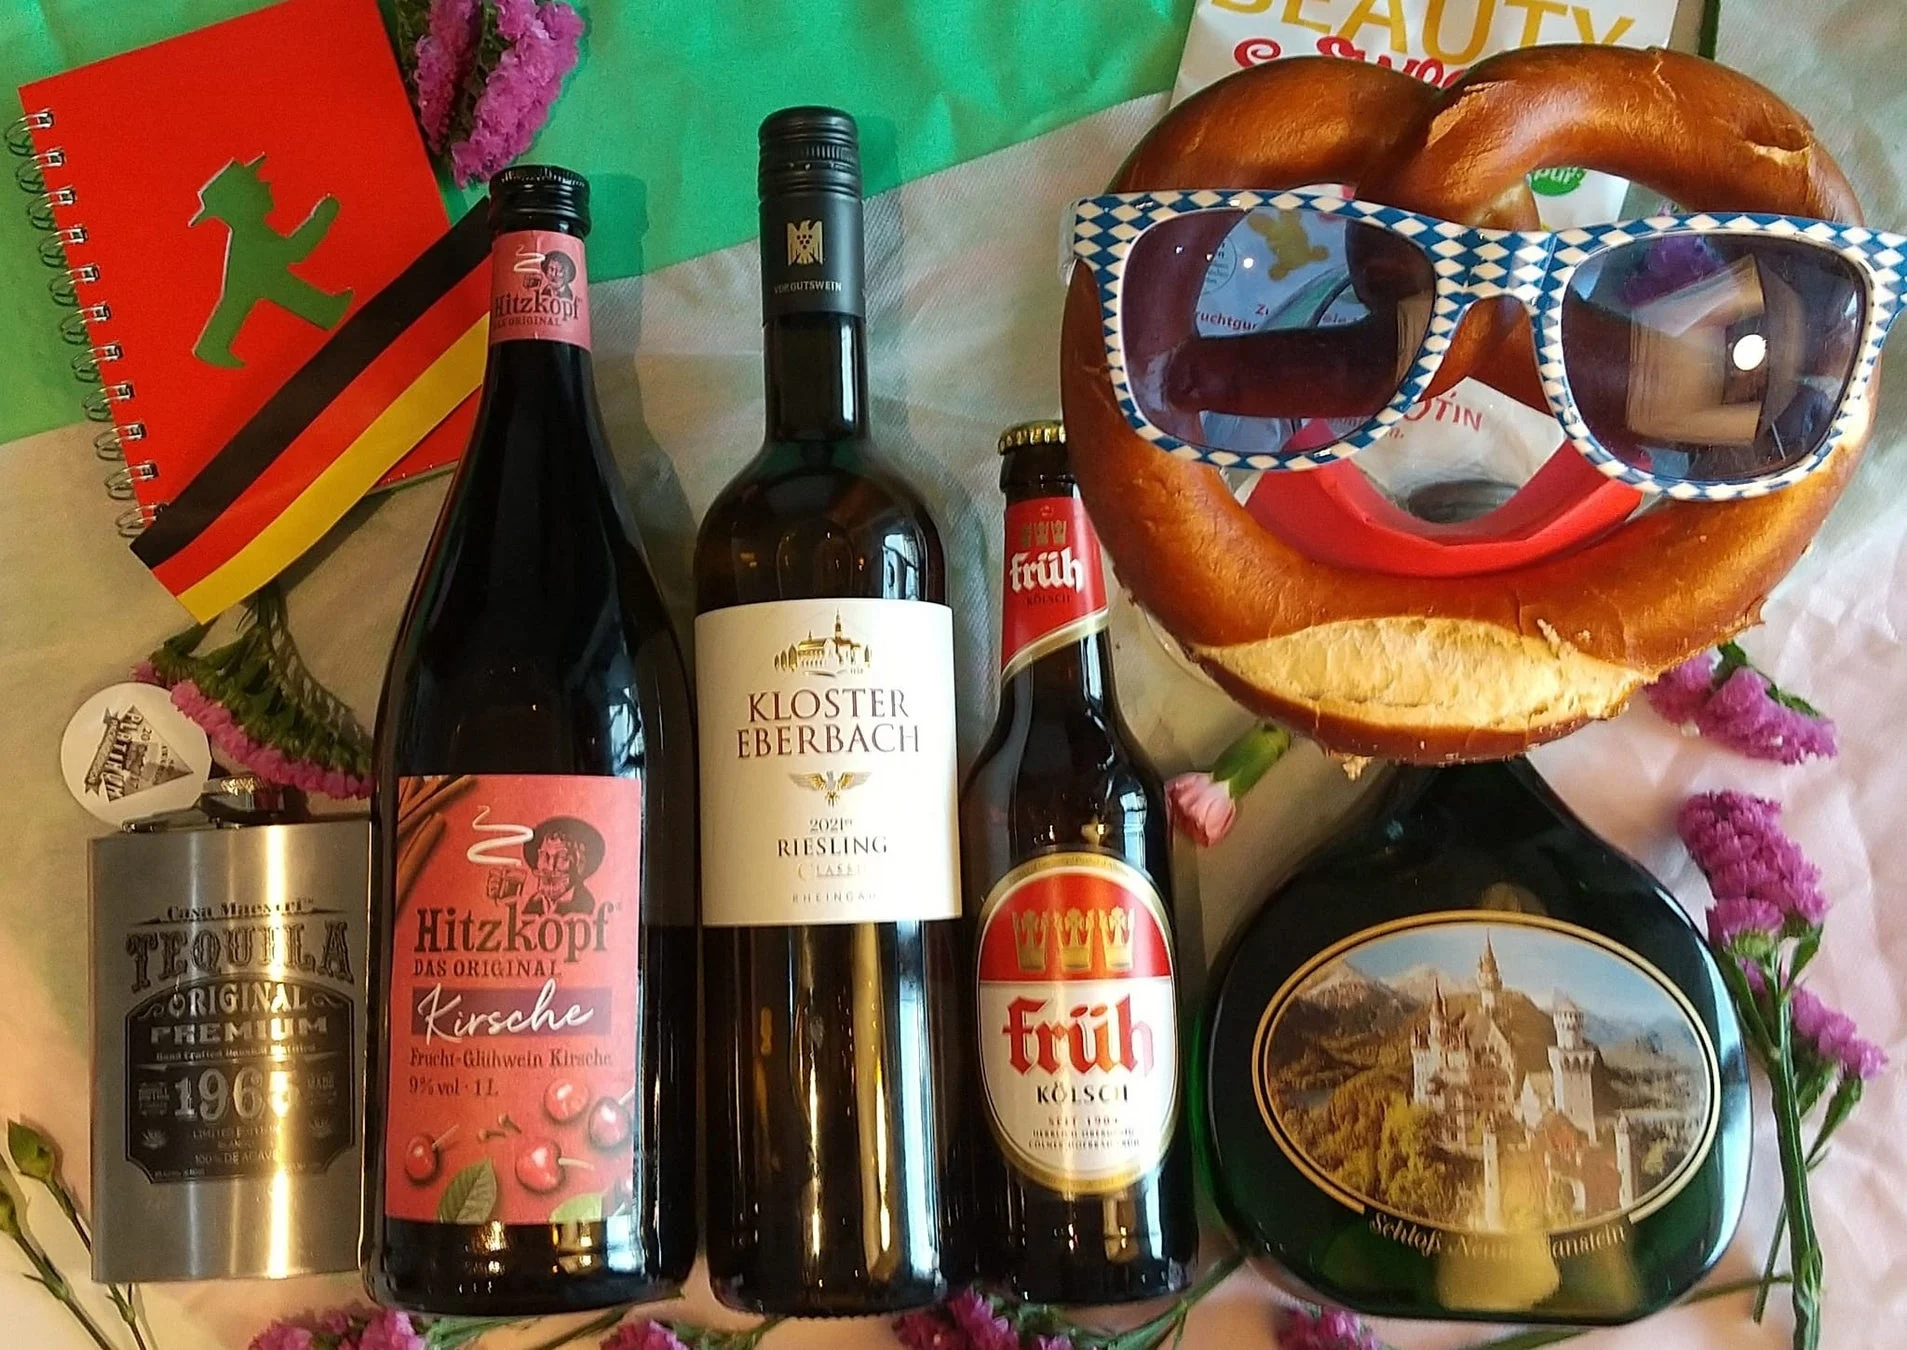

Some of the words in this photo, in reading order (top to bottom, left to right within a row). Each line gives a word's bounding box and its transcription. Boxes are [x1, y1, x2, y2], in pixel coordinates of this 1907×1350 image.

[1212, 0, 1635, 64] EAUTY
[495, 289, 579, 321] Hitzkopf
[1010, 546, 1084, 594] früh
[748, 689, 909, 722] KLOSTER
[737, 723, 919, 759] EBERBACH
[778, 836, 887, 857] RIESLING
[167, 904, 213, 921] Casa
[414, 902, 614, 963] Hitzkopf
[126, 920, 354, 994] TEQUILA
[414, 959, 447, 977] DAS
[453, 956, 562, 978] ORIGINAL
[168, 982, 308, 1017] ORIGINAL
[418, 978, 594, 1045] Kirsche
[151, 1016, 327, 1045] PREMIUM
[1002, 994, 1154, 1078] früh
[411, 1048, 543, 1069] Frucht-Glühwein
[550, 1048, 612, 1068] Kirsche
[1037, 1082, 1128, 1104] KÖLSCH
